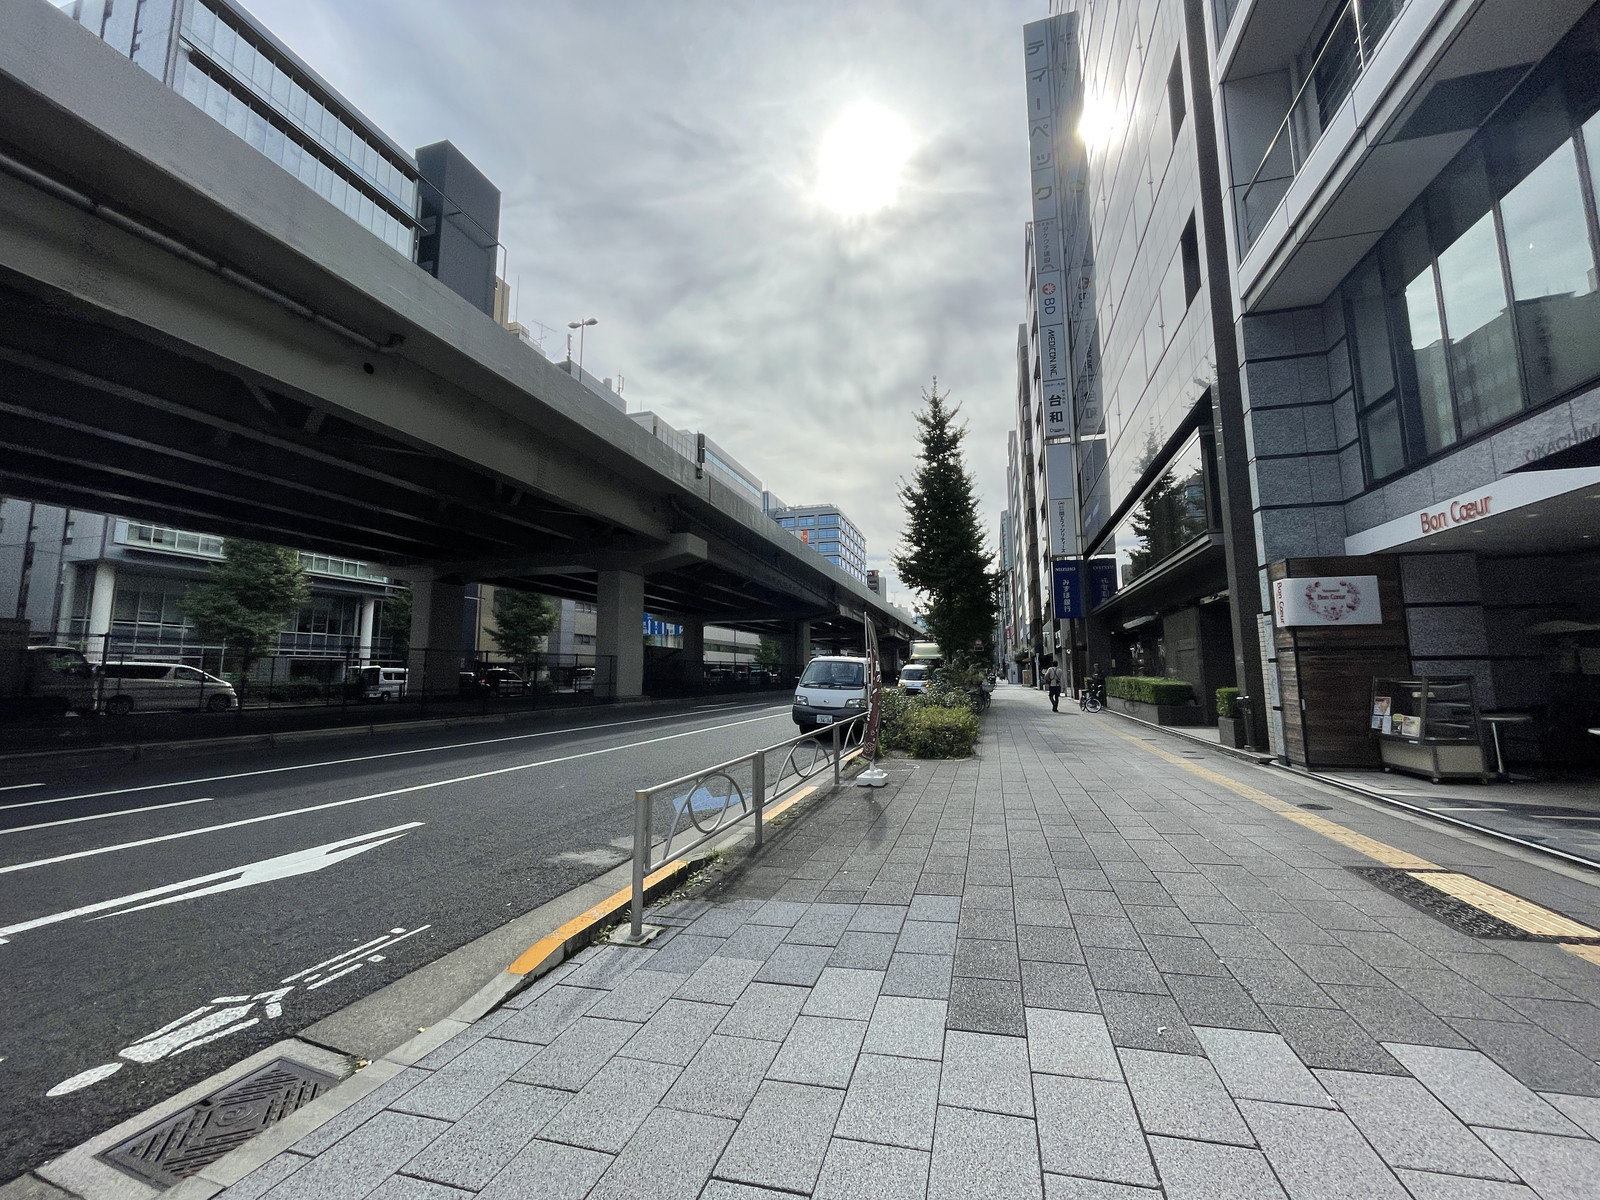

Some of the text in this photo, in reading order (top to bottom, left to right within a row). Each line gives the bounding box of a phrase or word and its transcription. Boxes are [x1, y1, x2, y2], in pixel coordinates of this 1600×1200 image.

[1044, 297, 1056, 315] BD
[1420, 512, 1448, 534] Bon
[1062, 579, 1072, 613] みずほ銀行
